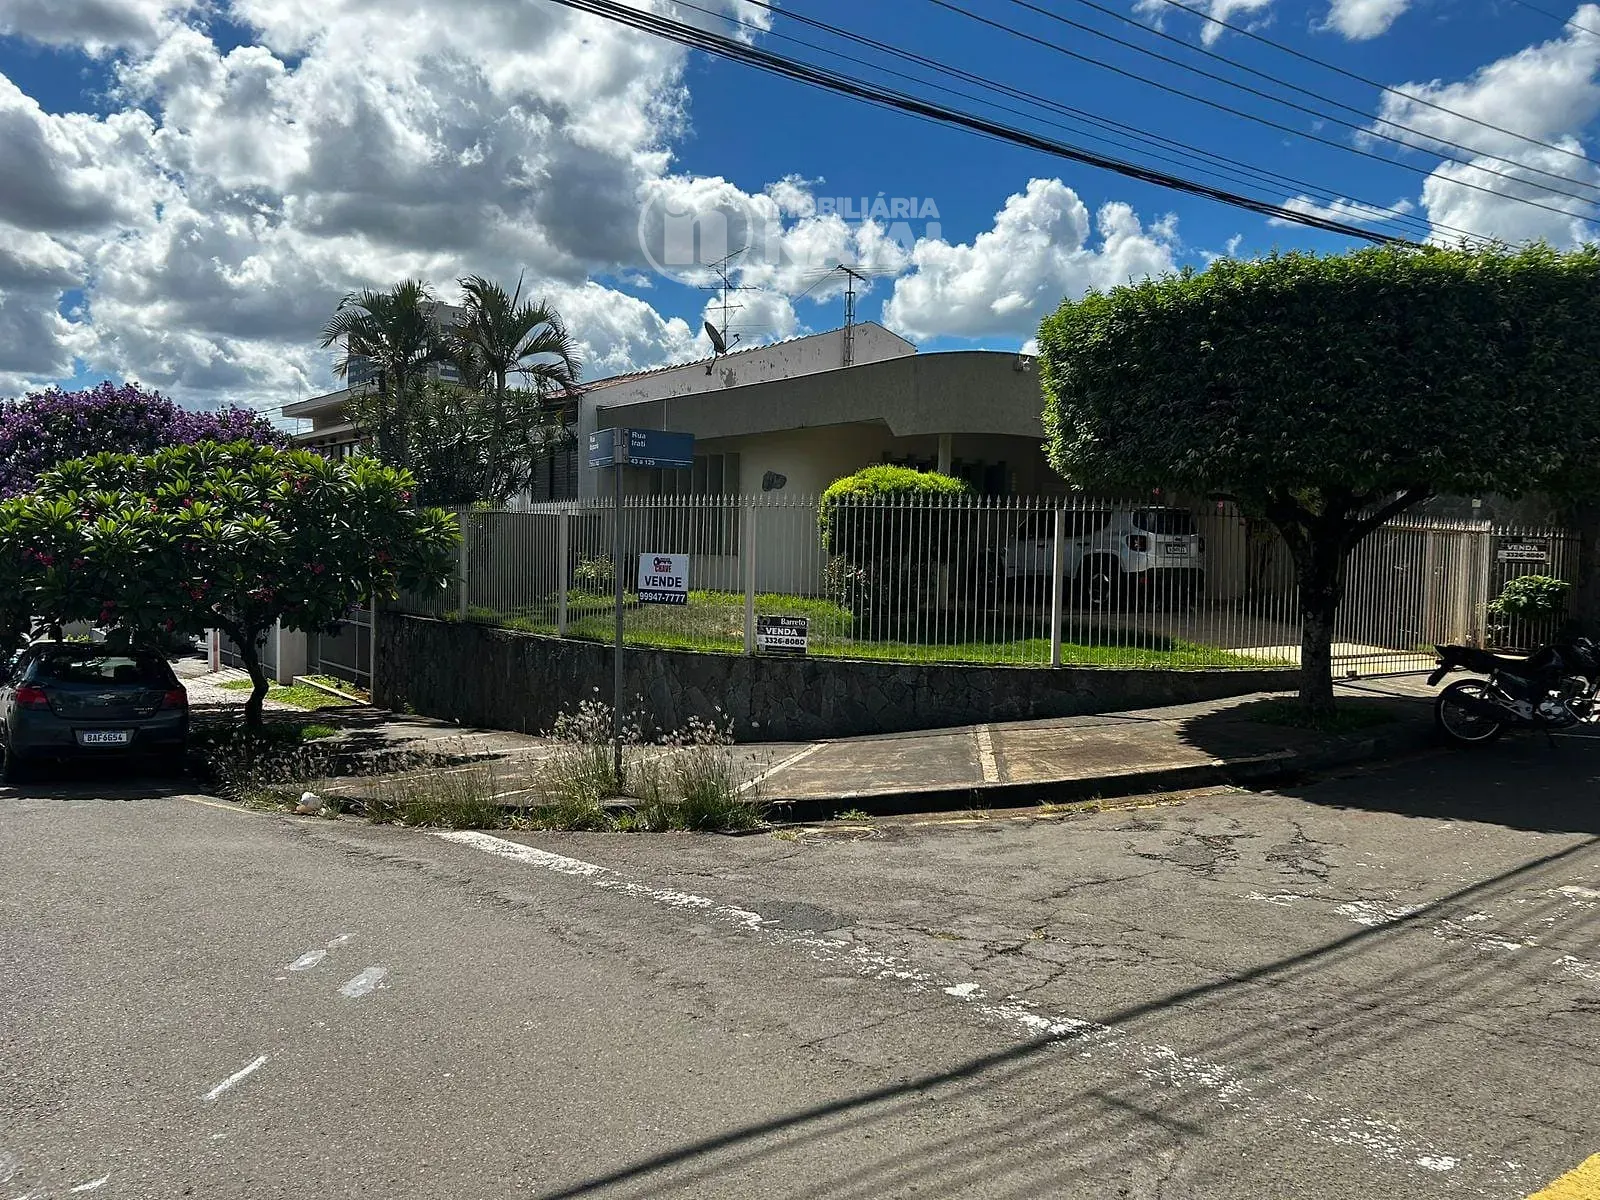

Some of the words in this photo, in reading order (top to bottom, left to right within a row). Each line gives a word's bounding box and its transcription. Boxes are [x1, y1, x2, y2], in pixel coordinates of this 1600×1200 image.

[631, 431, 646, 439] Rua
[631, 440, 646, 448] Irati
[644, 575, 683, 588] VENDE
[639, 591, 686, 603] 99947-7777
[780, 617, 807, 626] Barreto
[765, 627, 798, 636] VENDA
[764, 637, 806, 646] 3326-8080
[87, 733, 123, 742] BAF6G54
